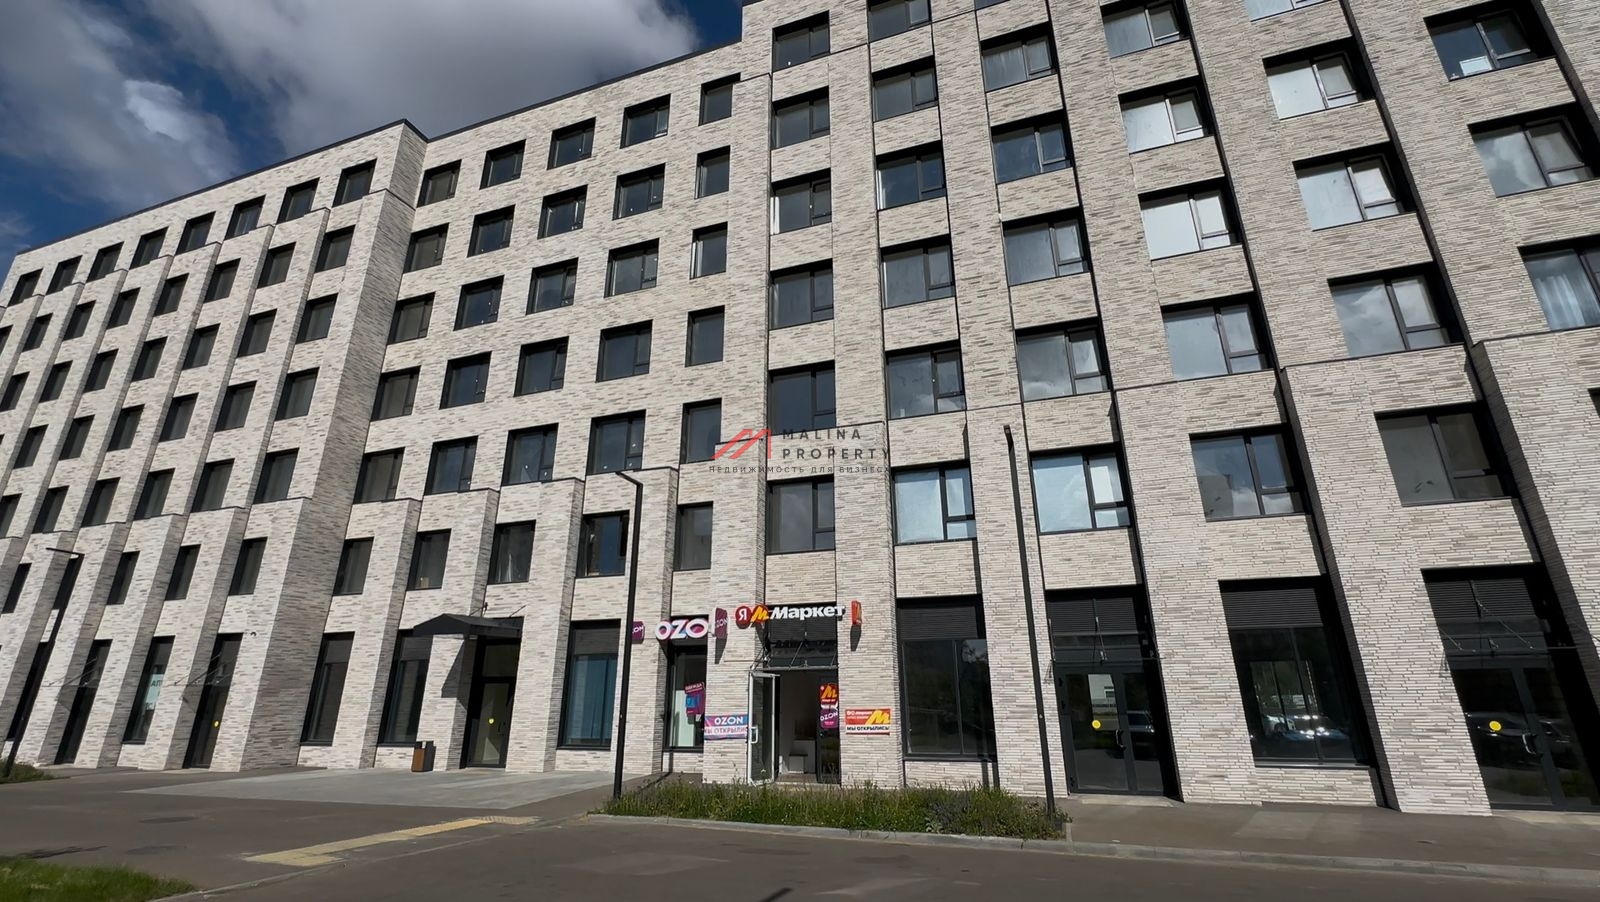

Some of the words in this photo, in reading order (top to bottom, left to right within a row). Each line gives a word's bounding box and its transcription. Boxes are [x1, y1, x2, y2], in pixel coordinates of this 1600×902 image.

[770, 605, 846, 621] Маркет
[714, 716, 744, 725] OZON
[820, 711, 838, 721] OZON
